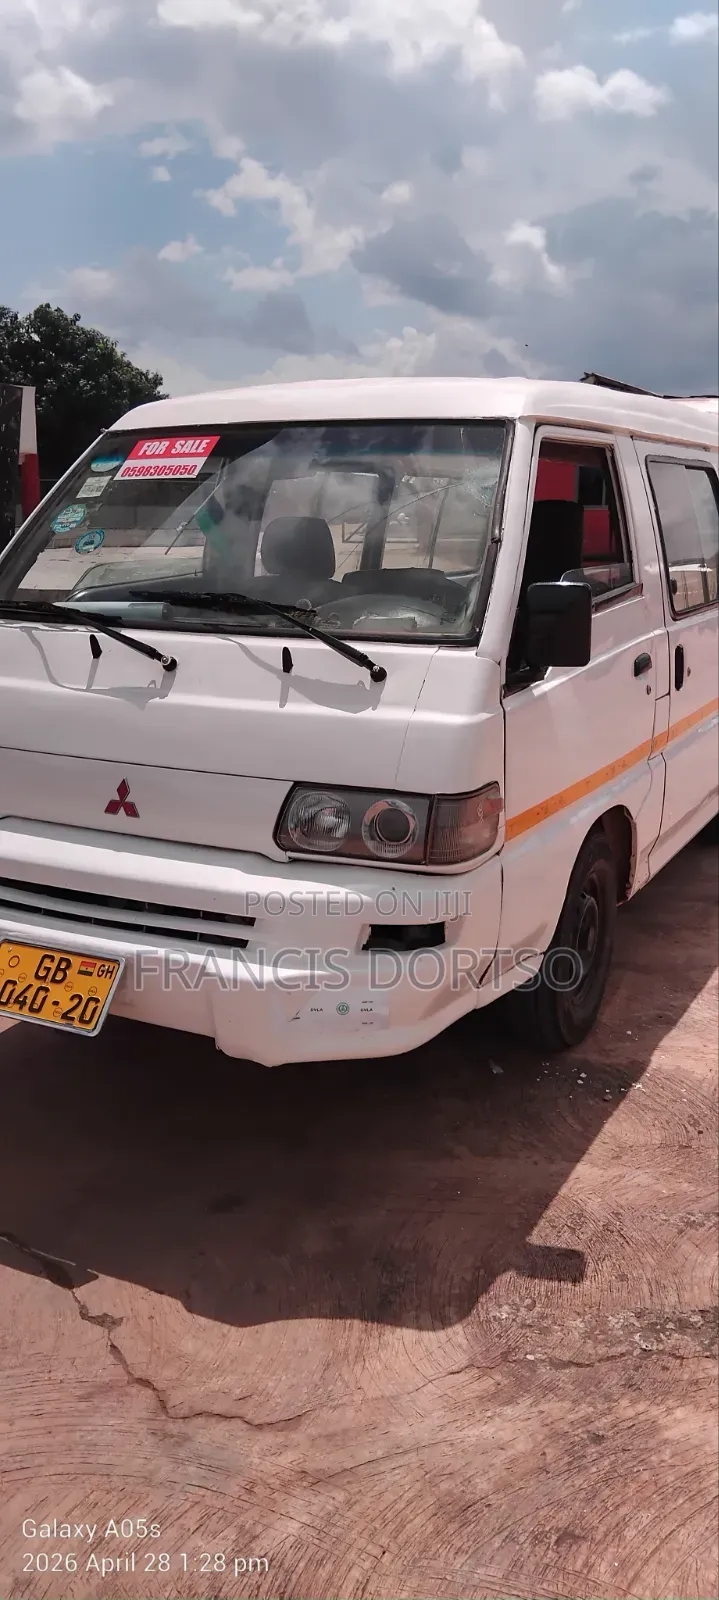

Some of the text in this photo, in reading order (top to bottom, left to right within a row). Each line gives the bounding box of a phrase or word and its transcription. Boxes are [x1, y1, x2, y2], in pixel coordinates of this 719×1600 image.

[138, 439, 210, 456] FOR SALE
[120, 465, 197, 478] 0598305050
[34, 953, 116, 984] GB GH
